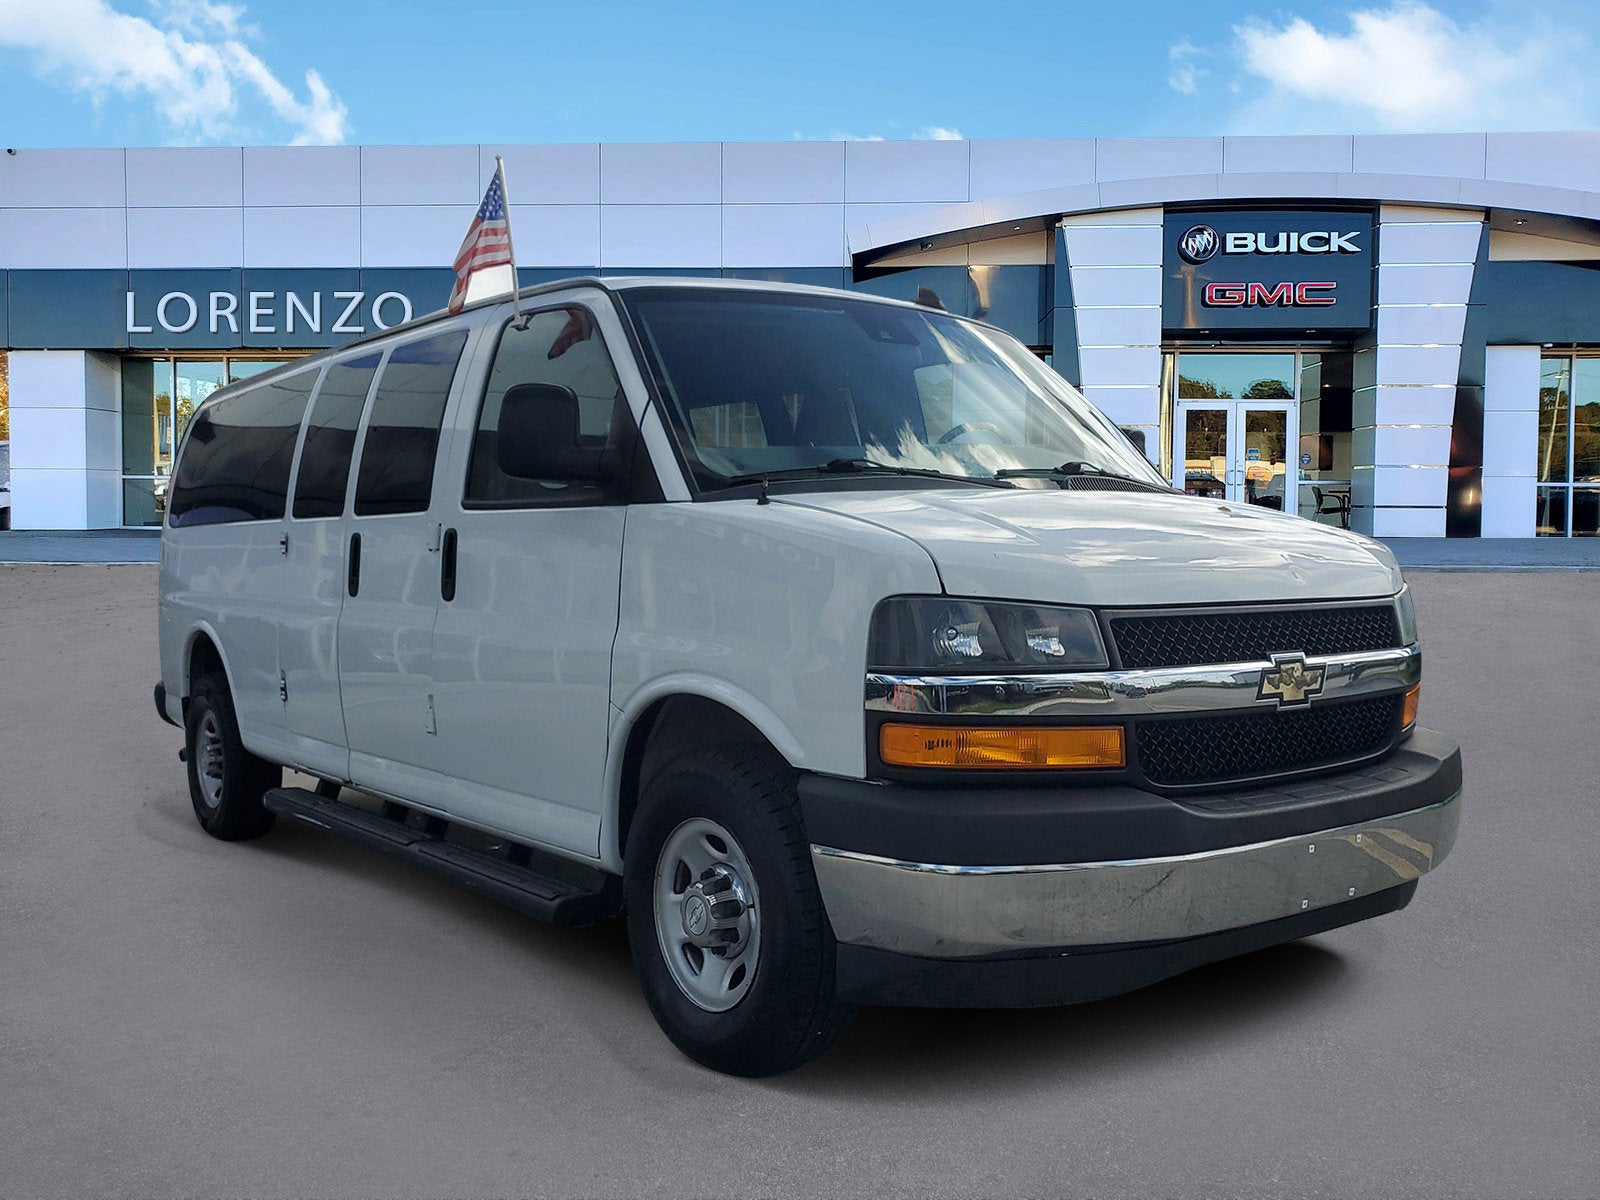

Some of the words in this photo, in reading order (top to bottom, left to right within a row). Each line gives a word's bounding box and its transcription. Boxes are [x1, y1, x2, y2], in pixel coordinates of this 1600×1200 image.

[1225, 231, 1362, 253] BUICK
[1205, 282, 1337, 305] GMC
[126, 291, 413, 333] LORENZO
